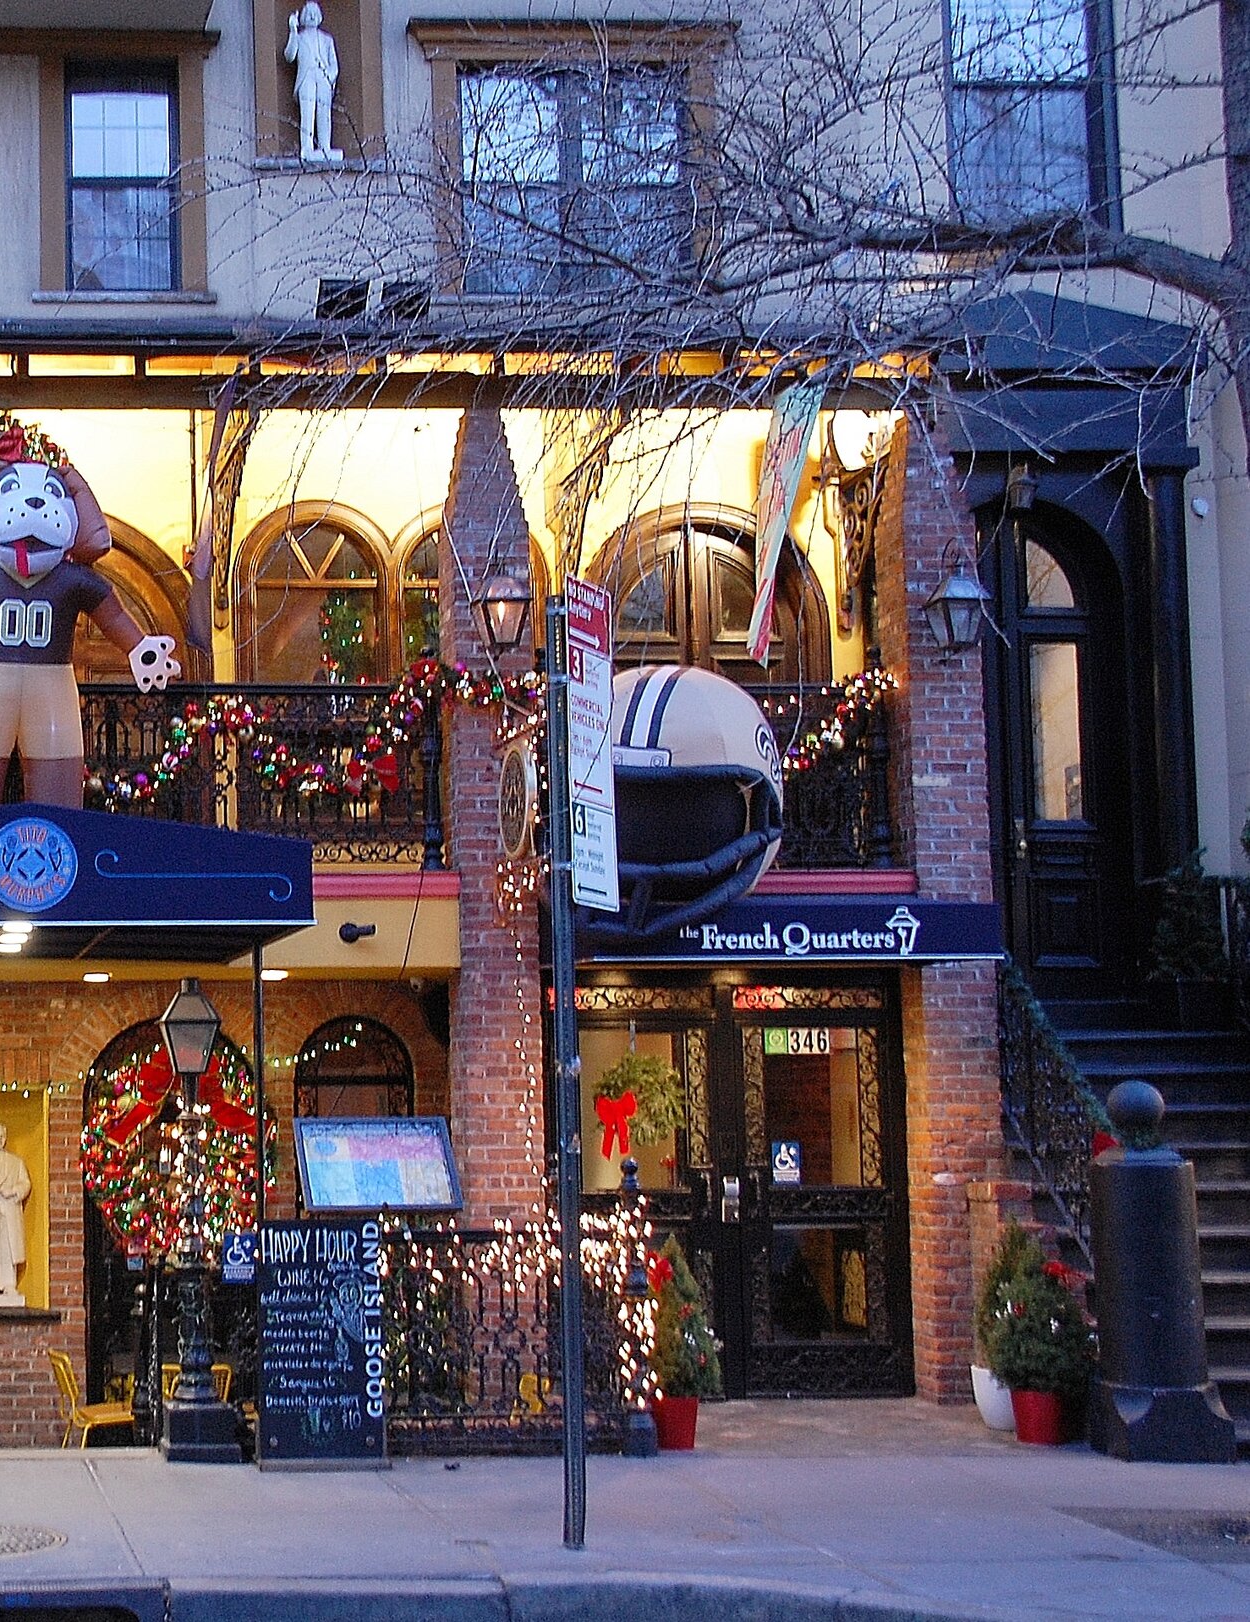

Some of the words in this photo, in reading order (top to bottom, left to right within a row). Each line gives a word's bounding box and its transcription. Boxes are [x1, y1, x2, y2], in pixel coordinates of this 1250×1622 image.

[572, 649, 581, 680] 3
[574, 804, 584, 835] 6
[701, 921, 780, 950] French
[782, 921, 896, 956] Quarters
[790, 1030, 827, 1053] 346
[260, 1227, 311, 1264] HAPPY
[315, 1227, 358, 1263] HOUR
[362, 1221, 382, 1317] ISLAND
[364, 1326, 383, 1418] GOOSE
